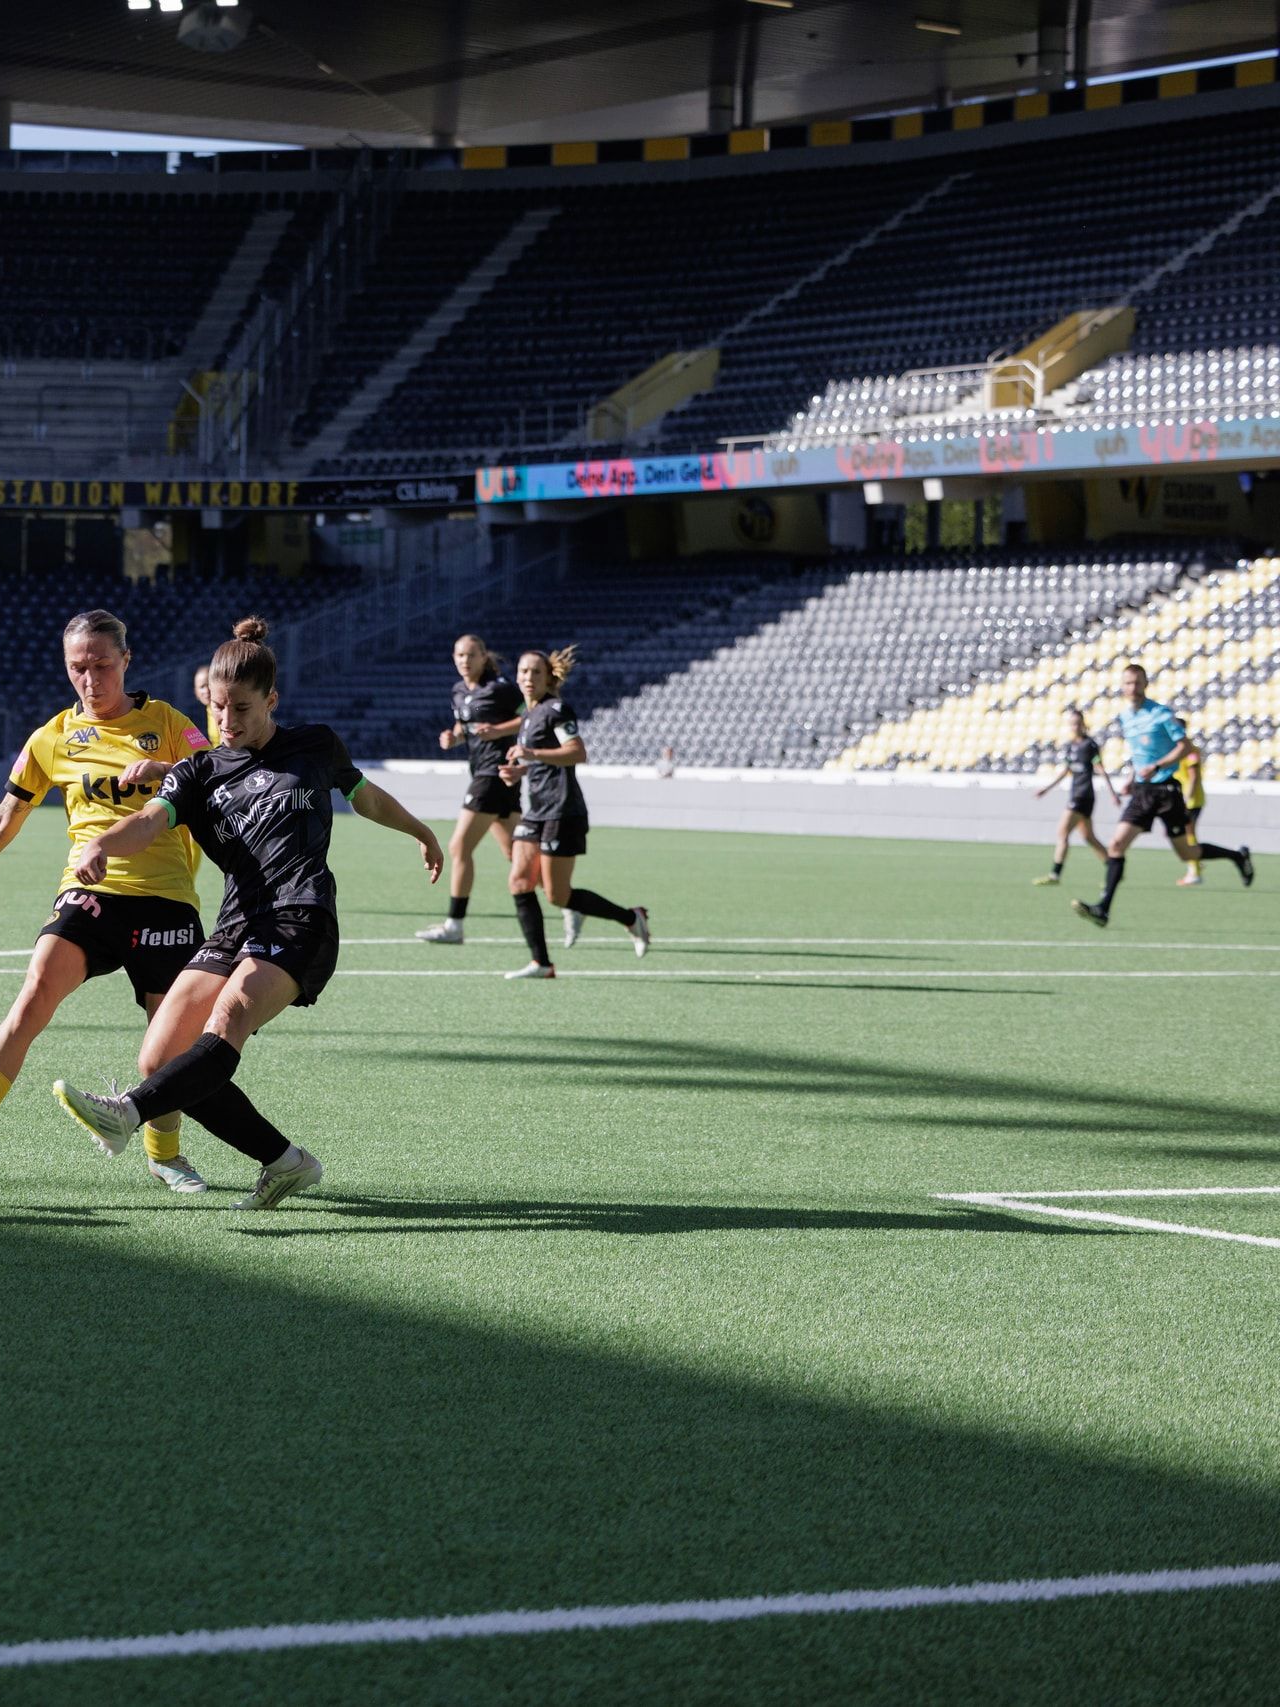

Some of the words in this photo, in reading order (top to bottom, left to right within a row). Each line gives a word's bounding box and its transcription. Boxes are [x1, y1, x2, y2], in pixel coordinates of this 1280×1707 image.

[567, 467, 606, 488] Deine
[645, 464, 676, 484] Dein
[145, 480, 299, 505] WANKDORF
[65, 726, 101, 744] AXA
[213, 787, 315, 844] KINETIK
[54, 891, 101, 918] yuh
